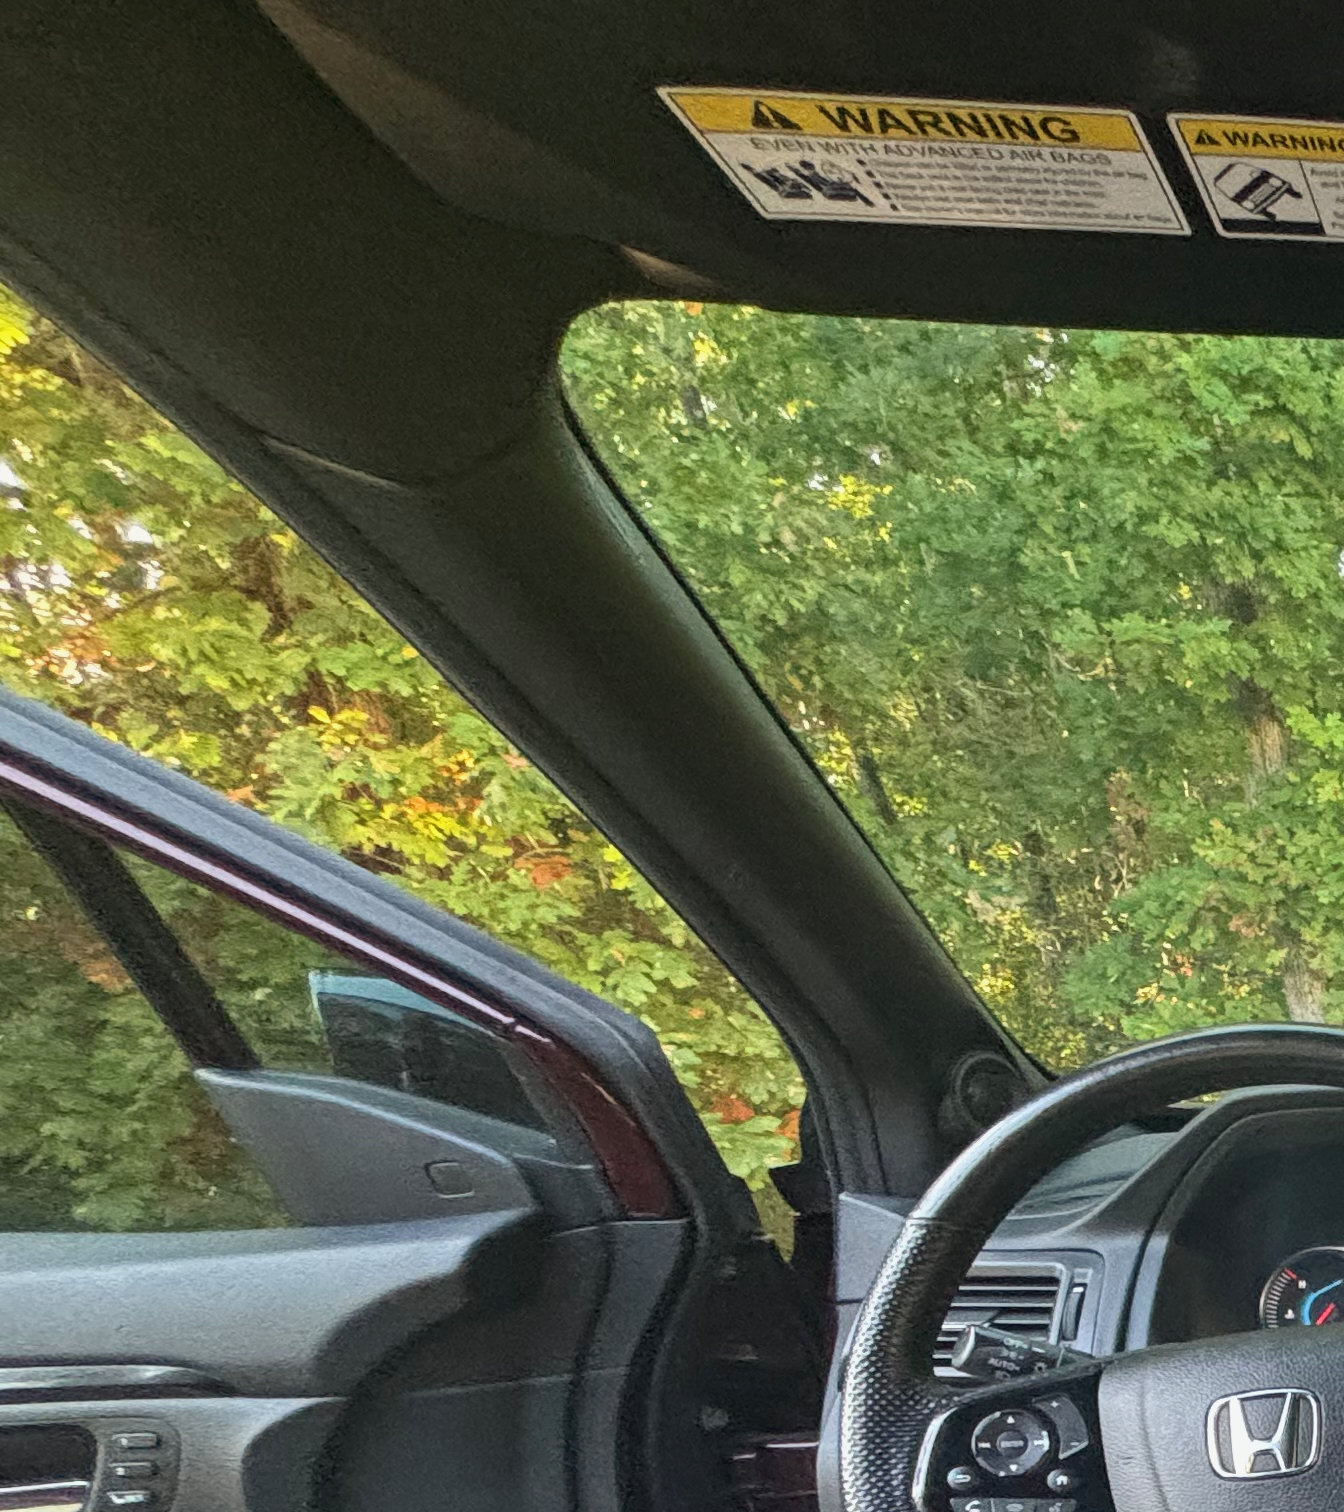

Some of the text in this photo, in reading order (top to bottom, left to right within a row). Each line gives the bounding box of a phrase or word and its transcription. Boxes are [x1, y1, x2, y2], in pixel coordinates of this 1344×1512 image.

[814, 104, 1081, 144] WARNING
[750, 136, 1112, 166] EVEN WITH ADVANCED AIR BAGS
